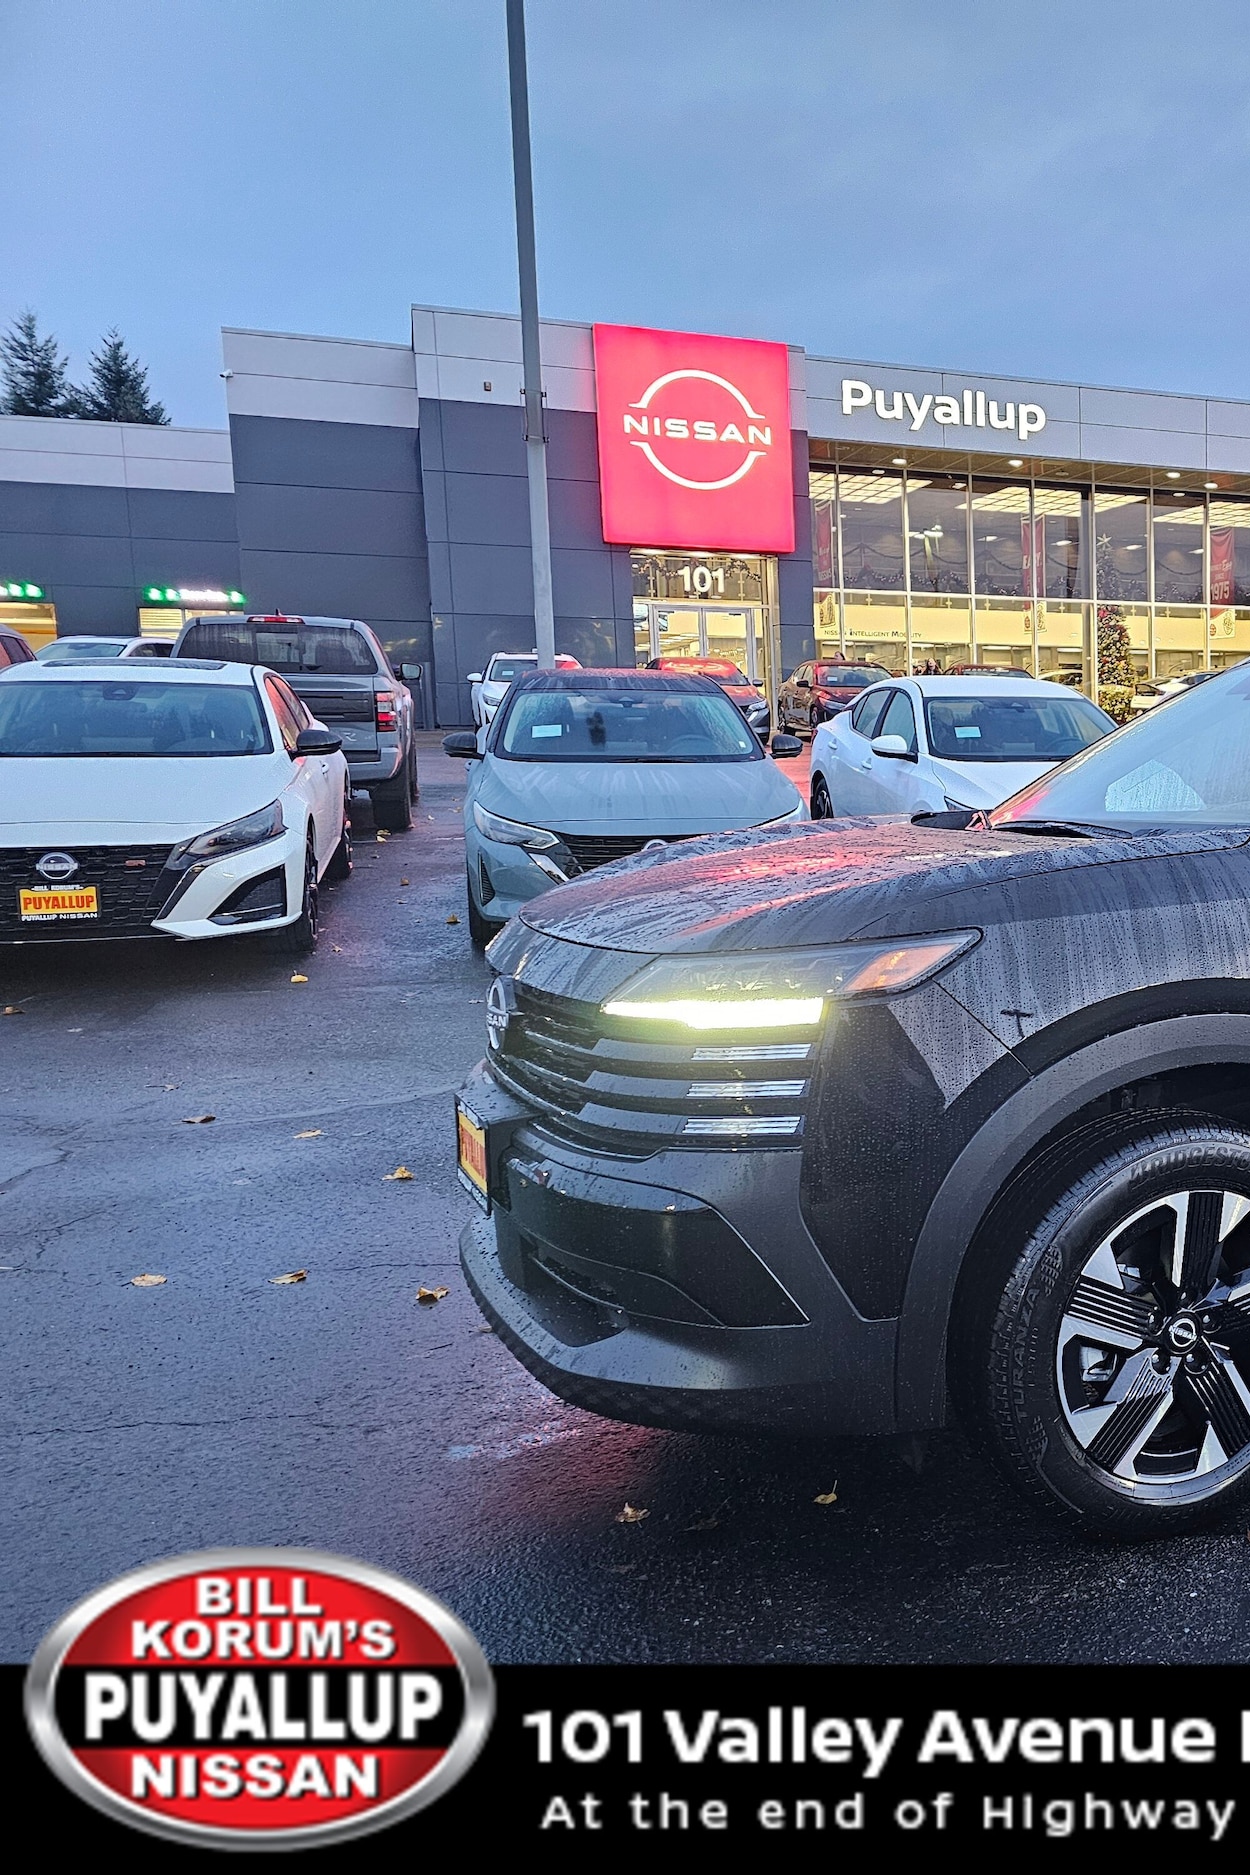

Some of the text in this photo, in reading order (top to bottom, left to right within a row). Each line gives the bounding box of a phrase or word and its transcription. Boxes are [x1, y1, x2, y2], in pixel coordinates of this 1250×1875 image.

[841, 379, 1048, 440] Puyallup
[623, 414, 773, 446] NISSAN
[677, 565, 726, 594] 101
[1211, 581, 1230, 600] 1975
[23, 895, 94, 910] PUYALLUP
[1012, 1288, 1041, 1423] TURANZA
